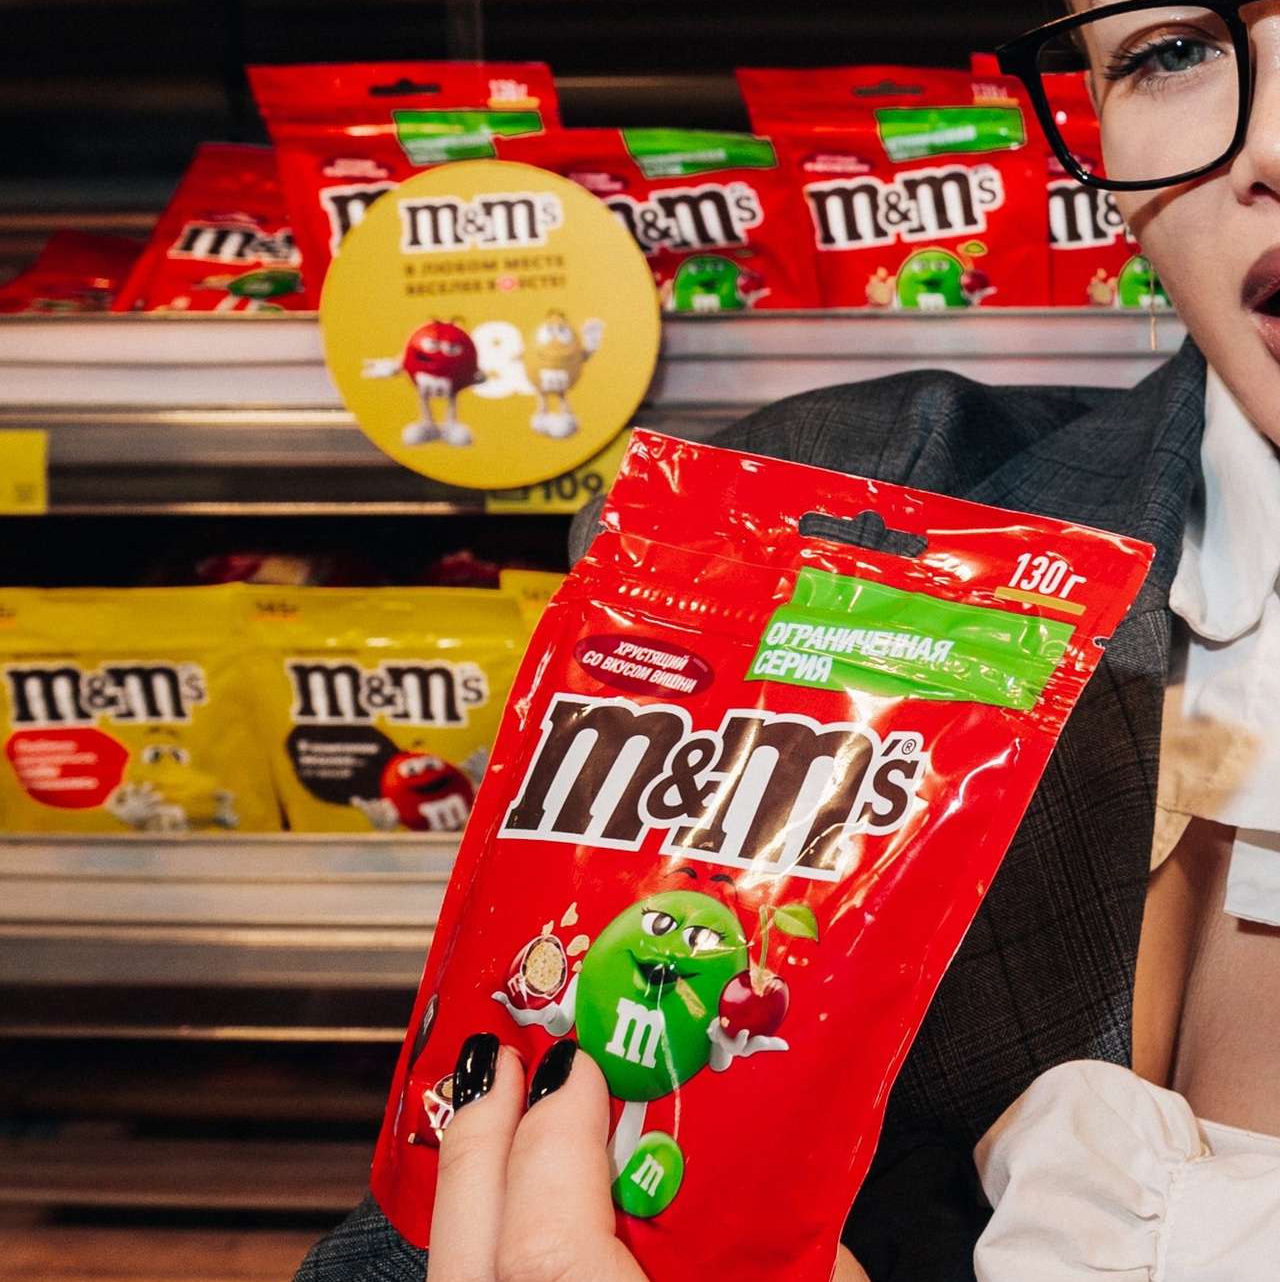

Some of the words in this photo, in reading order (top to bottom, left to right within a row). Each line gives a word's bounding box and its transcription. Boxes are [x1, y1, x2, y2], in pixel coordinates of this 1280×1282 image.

[613, 640, 691, 672] ХРУСТЯЩИЙ
[765, 620, 956, 663] ОГРАНИЧЕННАЯ
[582, 647, 604, 668] СО
[601, 655, 653, 682] ВКУСОМ
[649, 670, 698, 695] ВИШНИ
[752, 648, 834, 684] СЕРИЯ
[605, 997, 665, 1069] m
[630, 1153, 666, 1198] m
